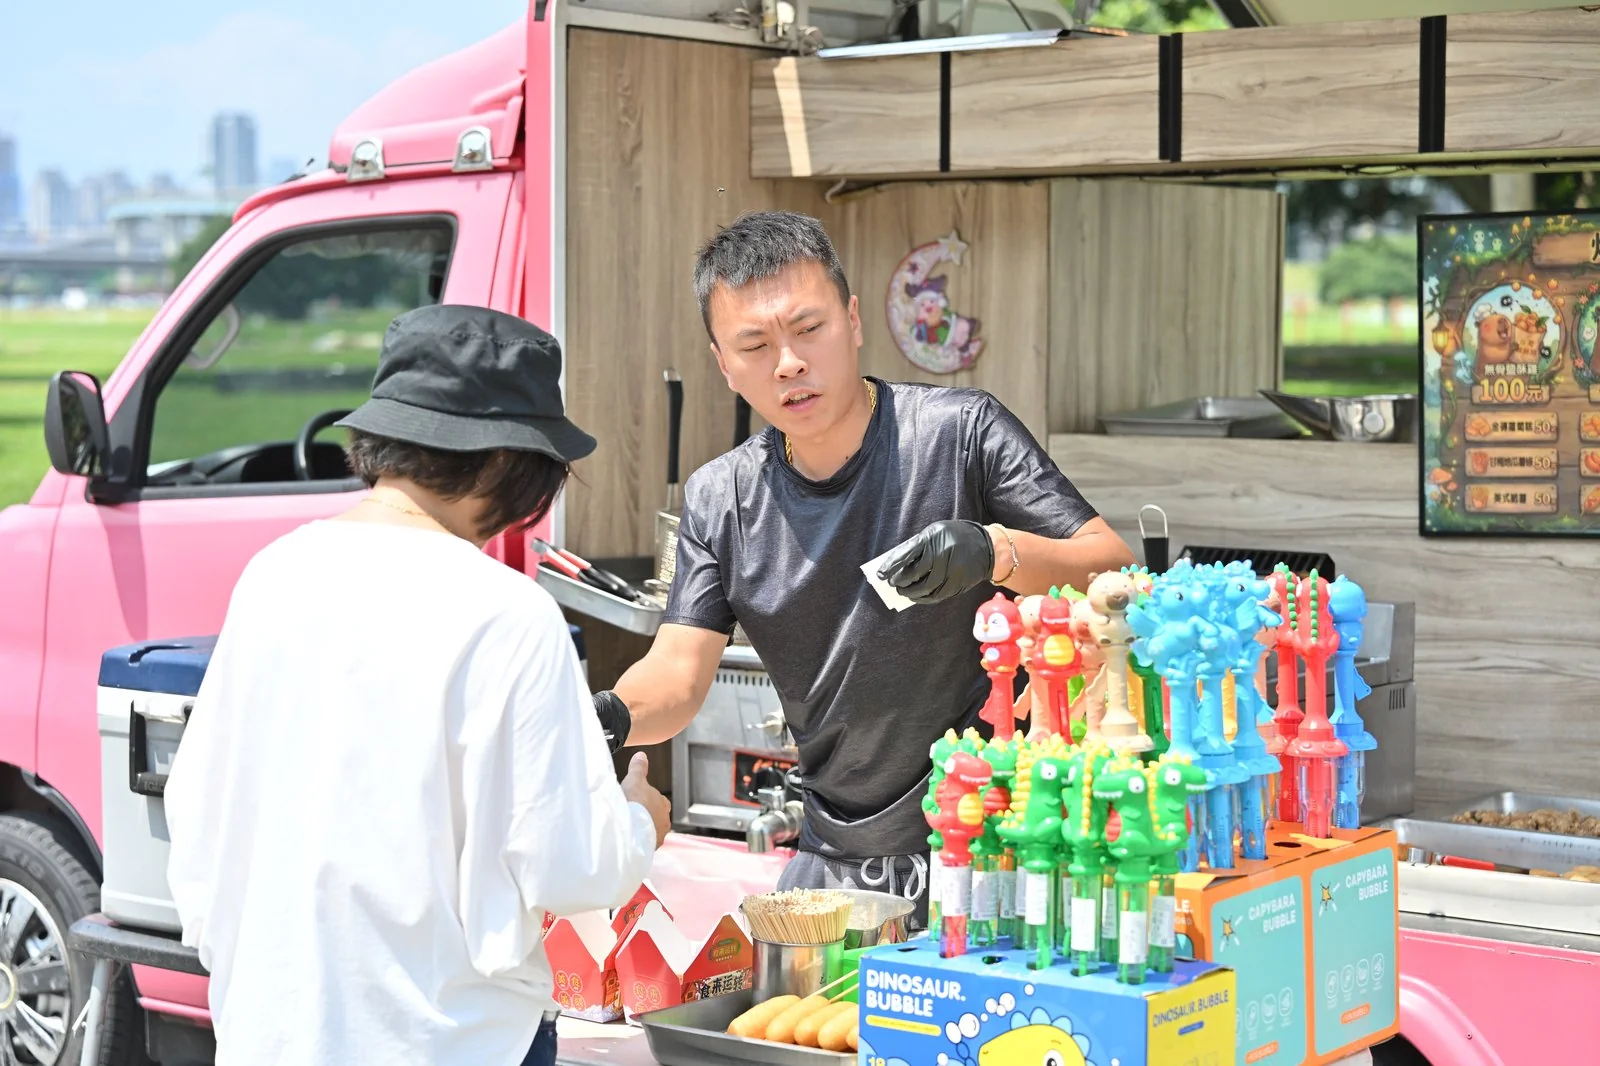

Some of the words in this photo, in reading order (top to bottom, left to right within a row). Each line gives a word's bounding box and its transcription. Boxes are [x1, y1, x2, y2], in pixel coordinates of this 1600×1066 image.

[1480, 377, 1544, 402] 100元
[1345, 863, 1388, 888] CAPYBARA
[1358, 879, 1389, 901] BUBBLE
[1248, 893, 1296, 921] CAPYBARA
[1262, 909, 1296, 934] BUBBLE
[866, 989, 934, 1018] BUBBLE
[1197, 989, 1228, 1012] BUBBLE
